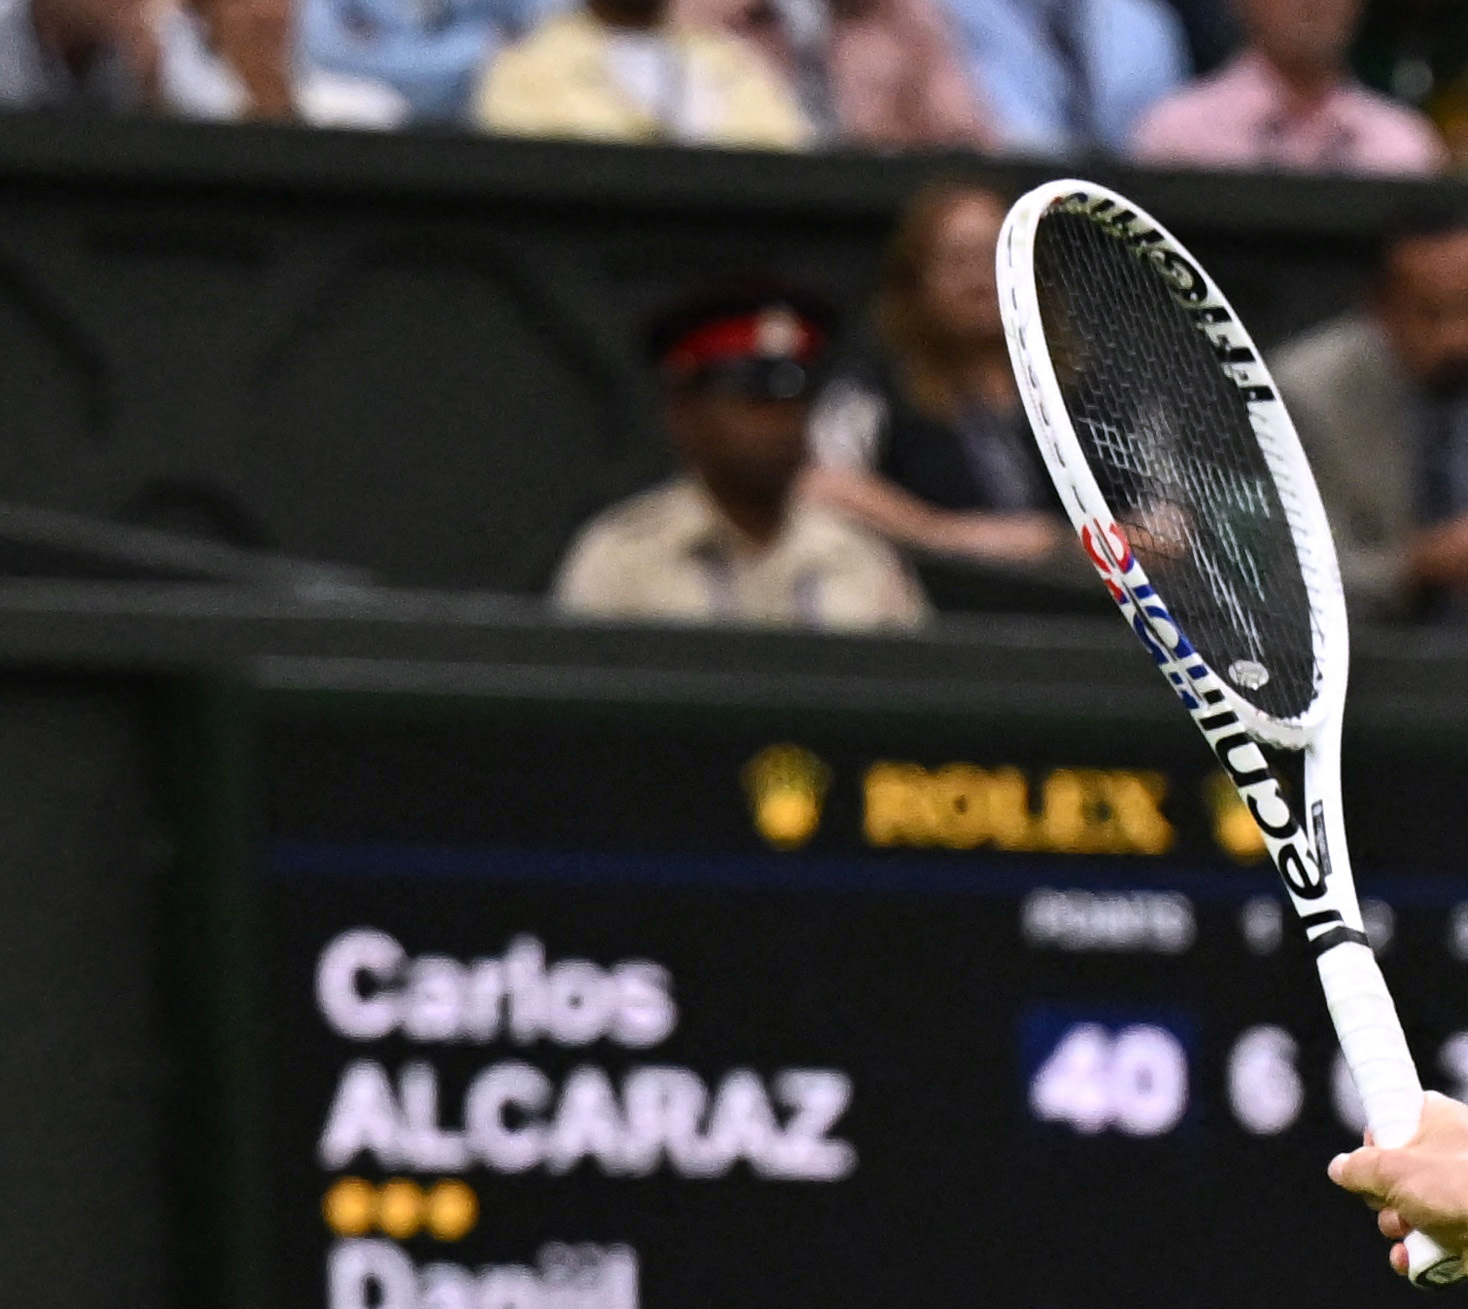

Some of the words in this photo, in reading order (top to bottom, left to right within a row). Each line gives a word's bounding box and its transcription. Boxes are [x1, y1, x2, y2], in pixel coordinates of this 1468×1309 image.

[862, 763, 1173, 855] ROLEX
[316, 930, 677, 1047] Carlos
[320, 1060, 856, 1182] ALCARAZ
[1030, 1024, 1189, 1136] 40
[1227, 1025, 1303, 1134] 6
